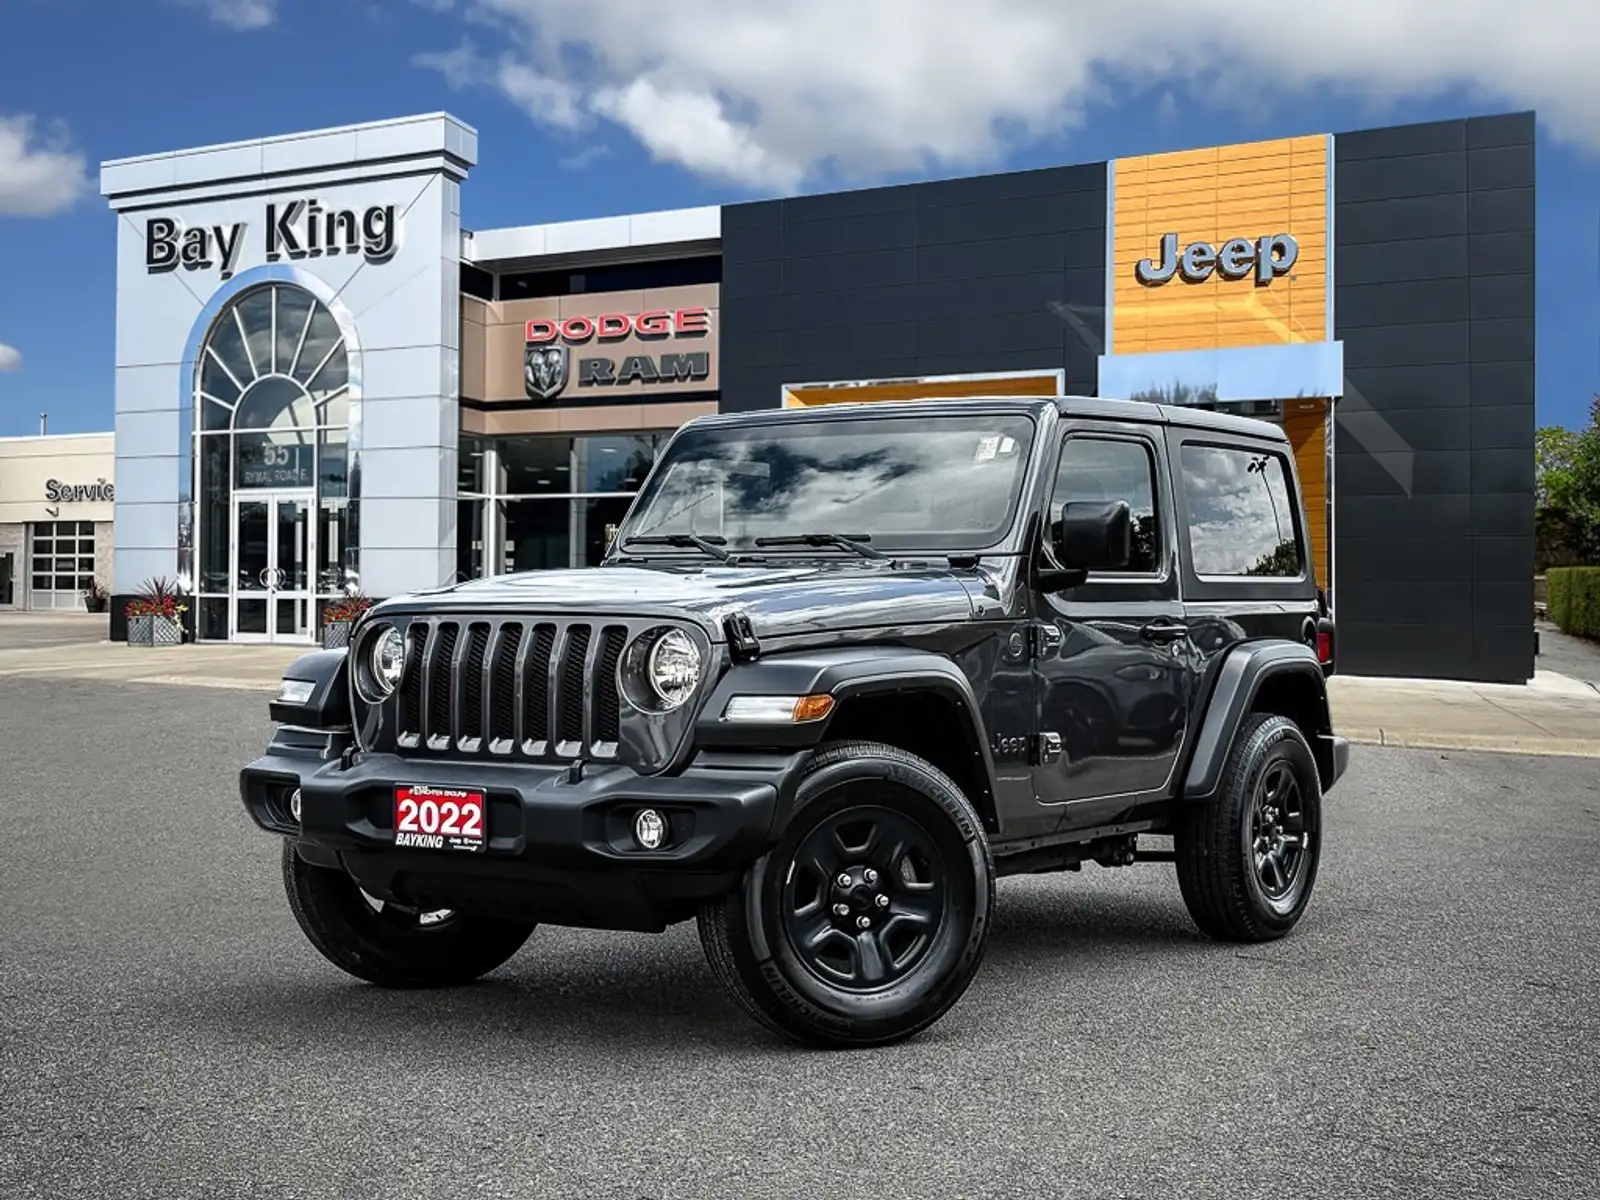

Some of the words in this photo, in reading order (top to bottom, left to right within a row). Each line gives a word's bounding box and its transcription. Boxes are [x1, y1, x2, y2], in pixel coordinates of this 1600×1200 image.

[144, 217, 247, 279] Bay
[264, 198, 399, 265] King
[1135, 232, 1299, 288] Jeep
[524, 307, 712, 346] DODGE
[578, 351, 710, 388] RAM
[260, 442, 290, 466] 55
[398, 798, 482, 836] 2022
[395, 832, 444, 848] BAYKING
